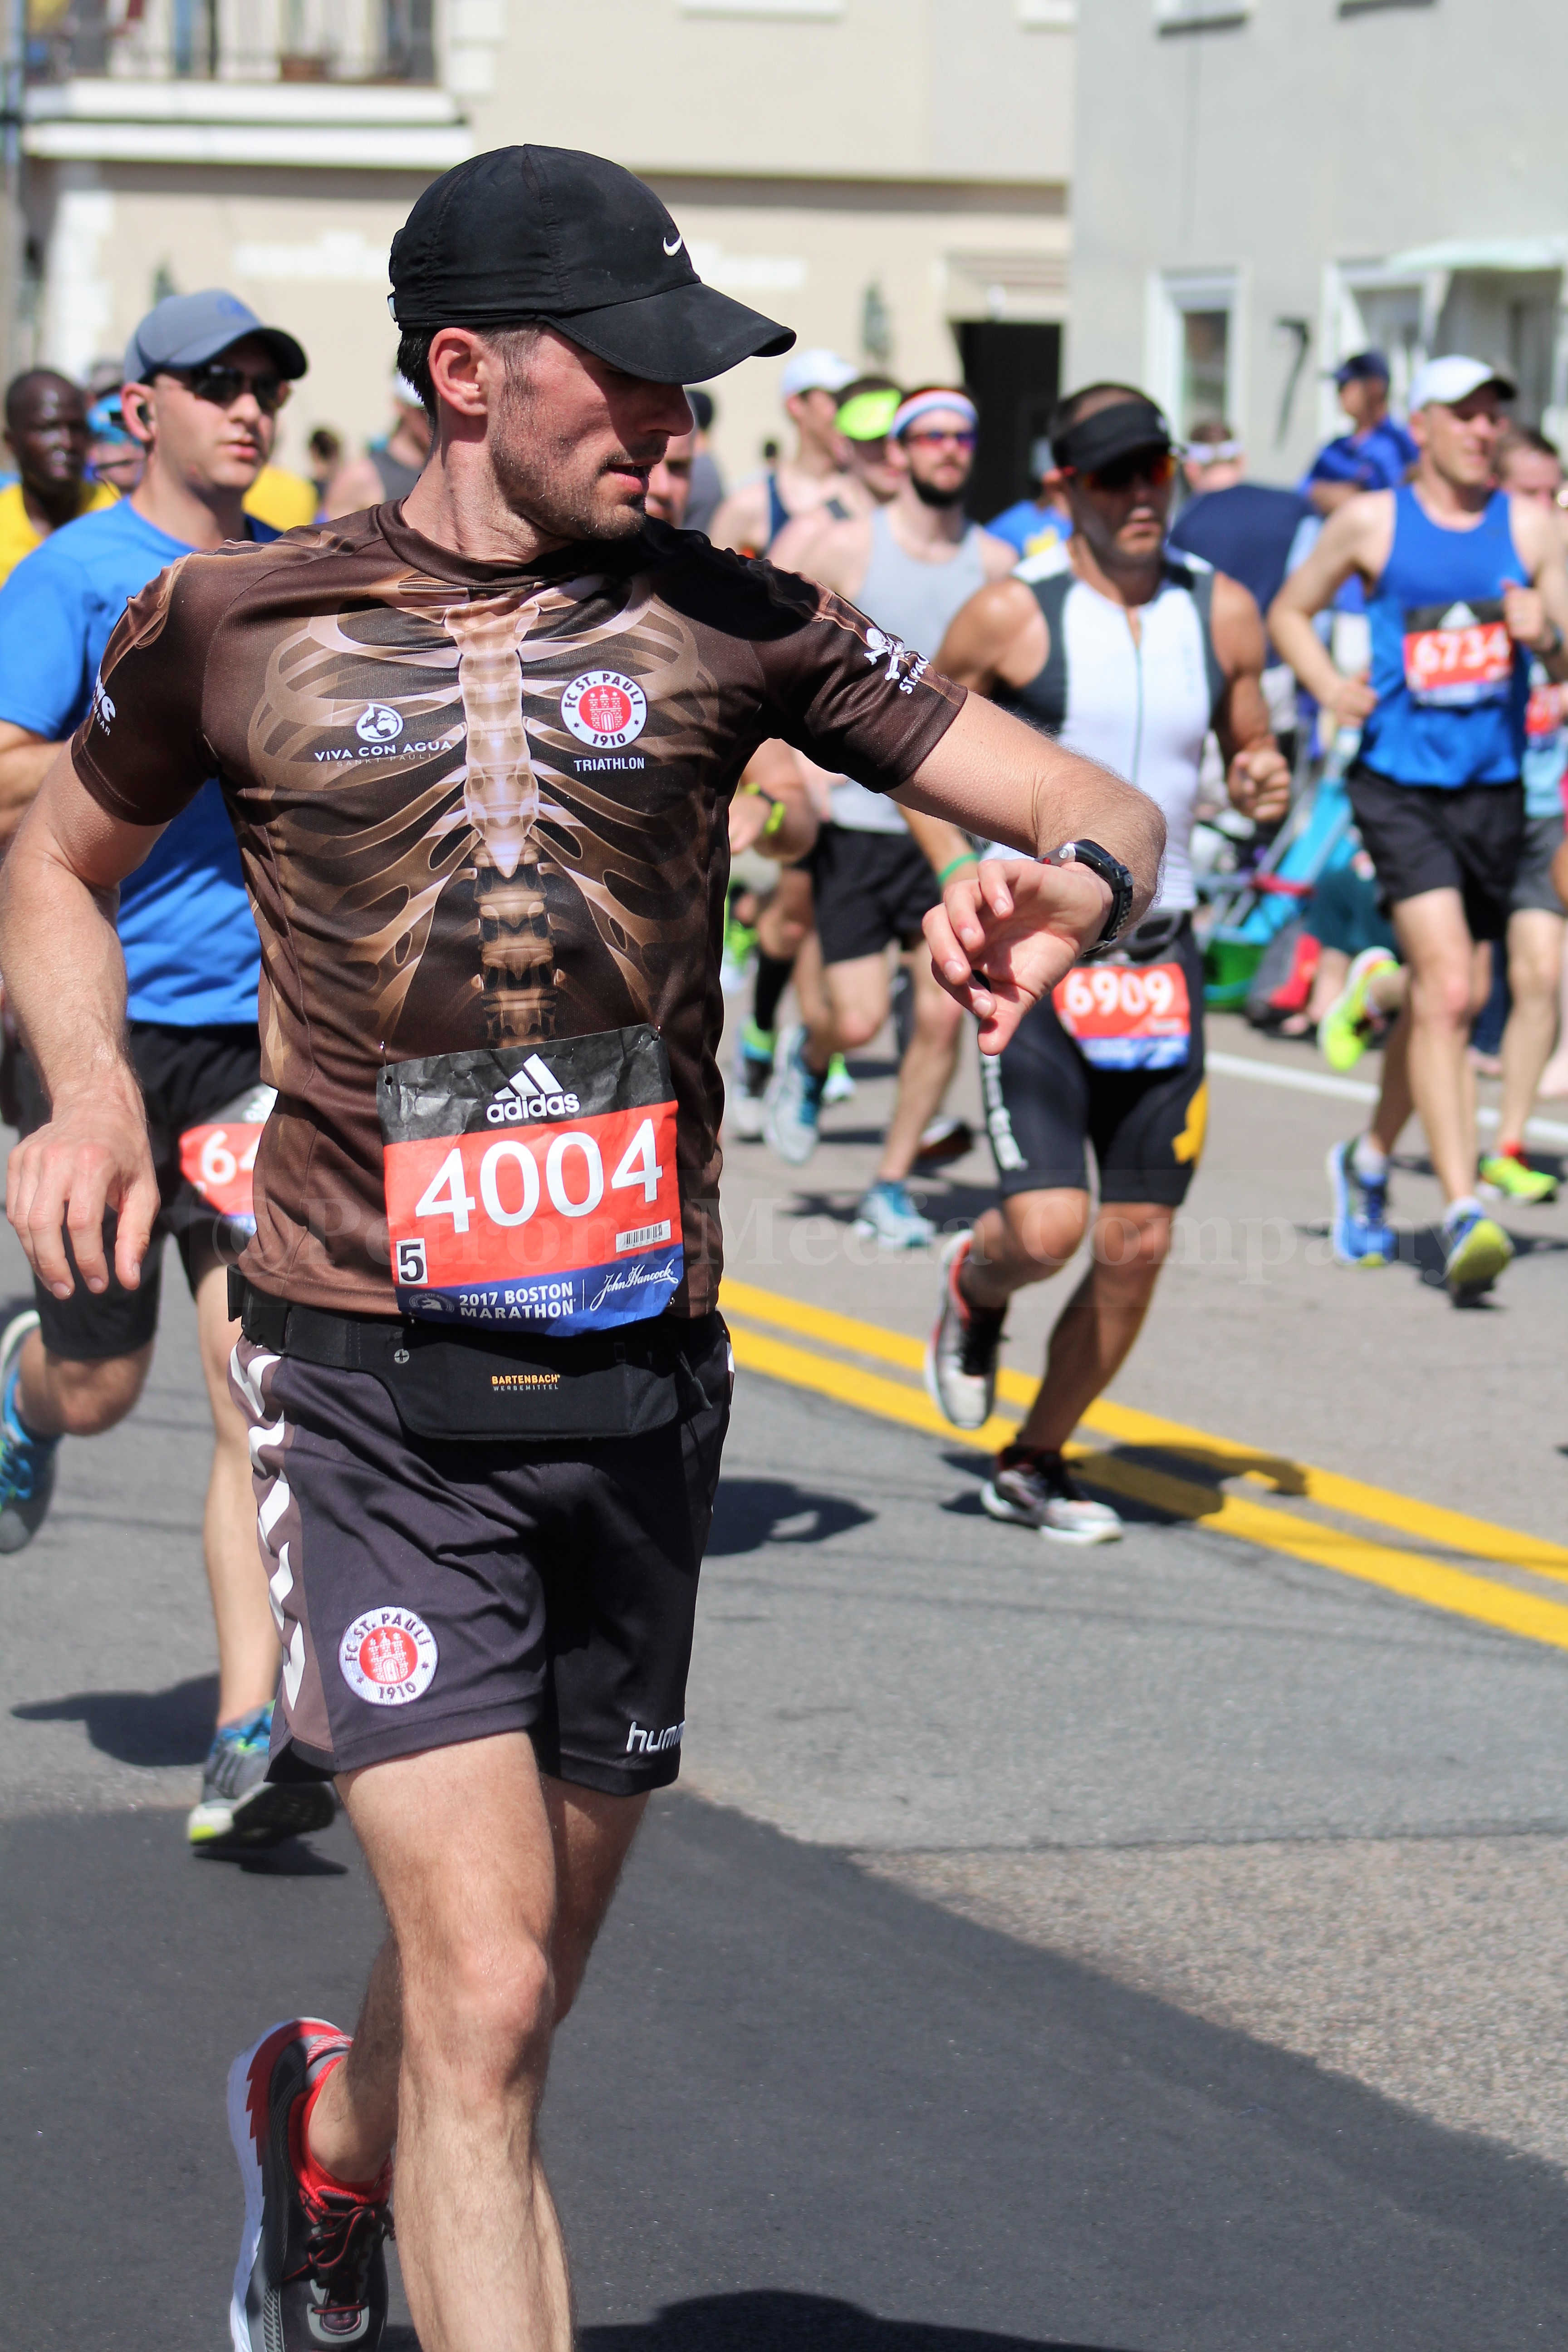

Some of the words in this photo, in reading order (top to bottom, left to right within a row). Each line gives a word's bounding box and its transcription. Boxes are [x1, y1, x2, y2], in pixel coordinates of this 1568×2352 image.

[564, 693, 578, 708] FC
[575, 676, 597, 691] ST.
[603, 673, 643, 705] PAULI
[314, 750, 353, 761] VIVA
[358, 745, 396, 757] CON
[403, 740, 453, 753] AGUA
[593, 733, 626, 746] 1910
[337, 757, 382, 767] SANKT
[573, 758, 644, 772] TRIATHLON
[1065, 970, 1174, 1016] 6909
[487, 1092, 580, 1123] adidas
[416, 1118, 663, 1233] 4004
[400, 1244, 424, 1282] 5
[459, 1291, 498, 1306] 2017
[505, 1281, 573, 1304] BOSTON
[461, 1298, 574, 1318] MARATHON
[345, 1644, 358, 1661] FC
[354, 1620, 376, 1640] ST.
[382, 1613, 431, 1645] PAULI
[379, 1682, 416, 1699] 1910
